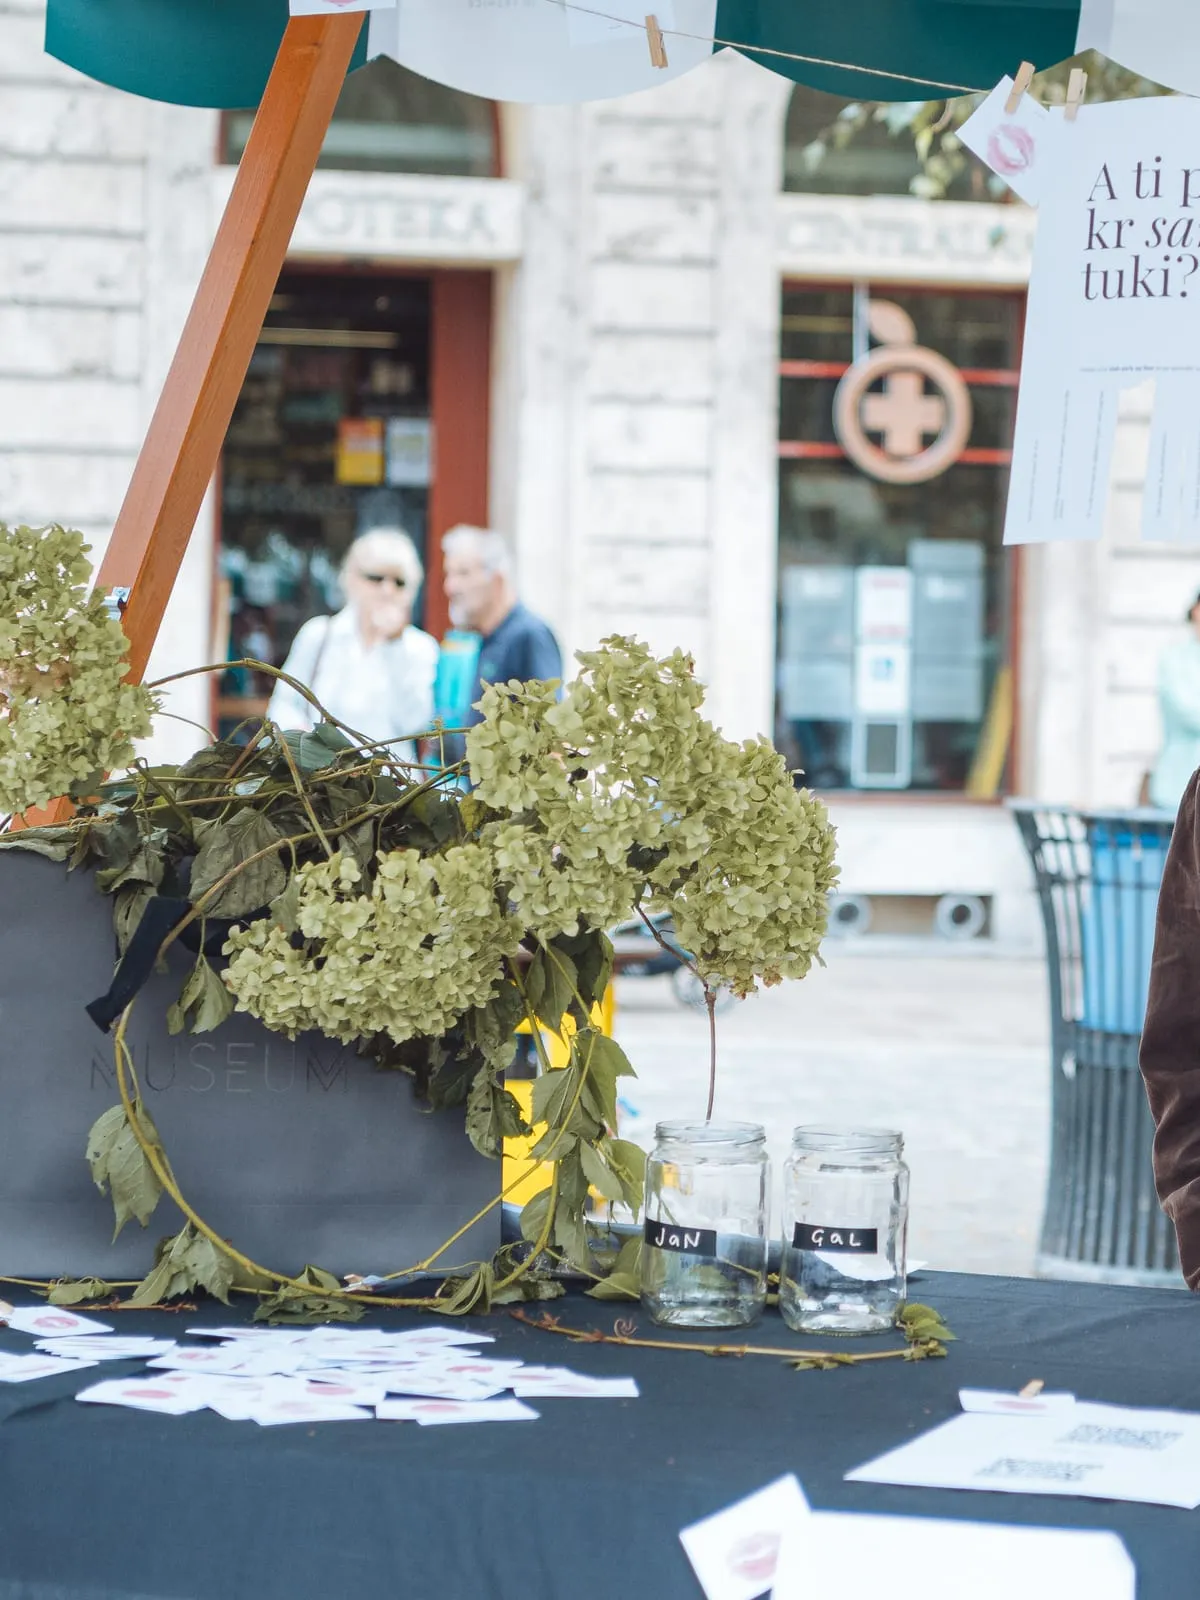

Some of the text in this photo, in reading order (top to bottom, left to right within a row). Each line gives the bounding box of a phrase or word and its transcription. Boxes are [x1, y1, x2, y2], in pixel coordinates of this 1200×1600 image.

[1086, 162, 1119, 202] A
[1132, 156, 1164, 200] ti
[307, 189, 498, 243] OTEKA
[1083, 207, 1135, 250] kr
[1080, 253, 1199, 300] tuki?
[89, 1041, 350, 1093] MUSEUM
